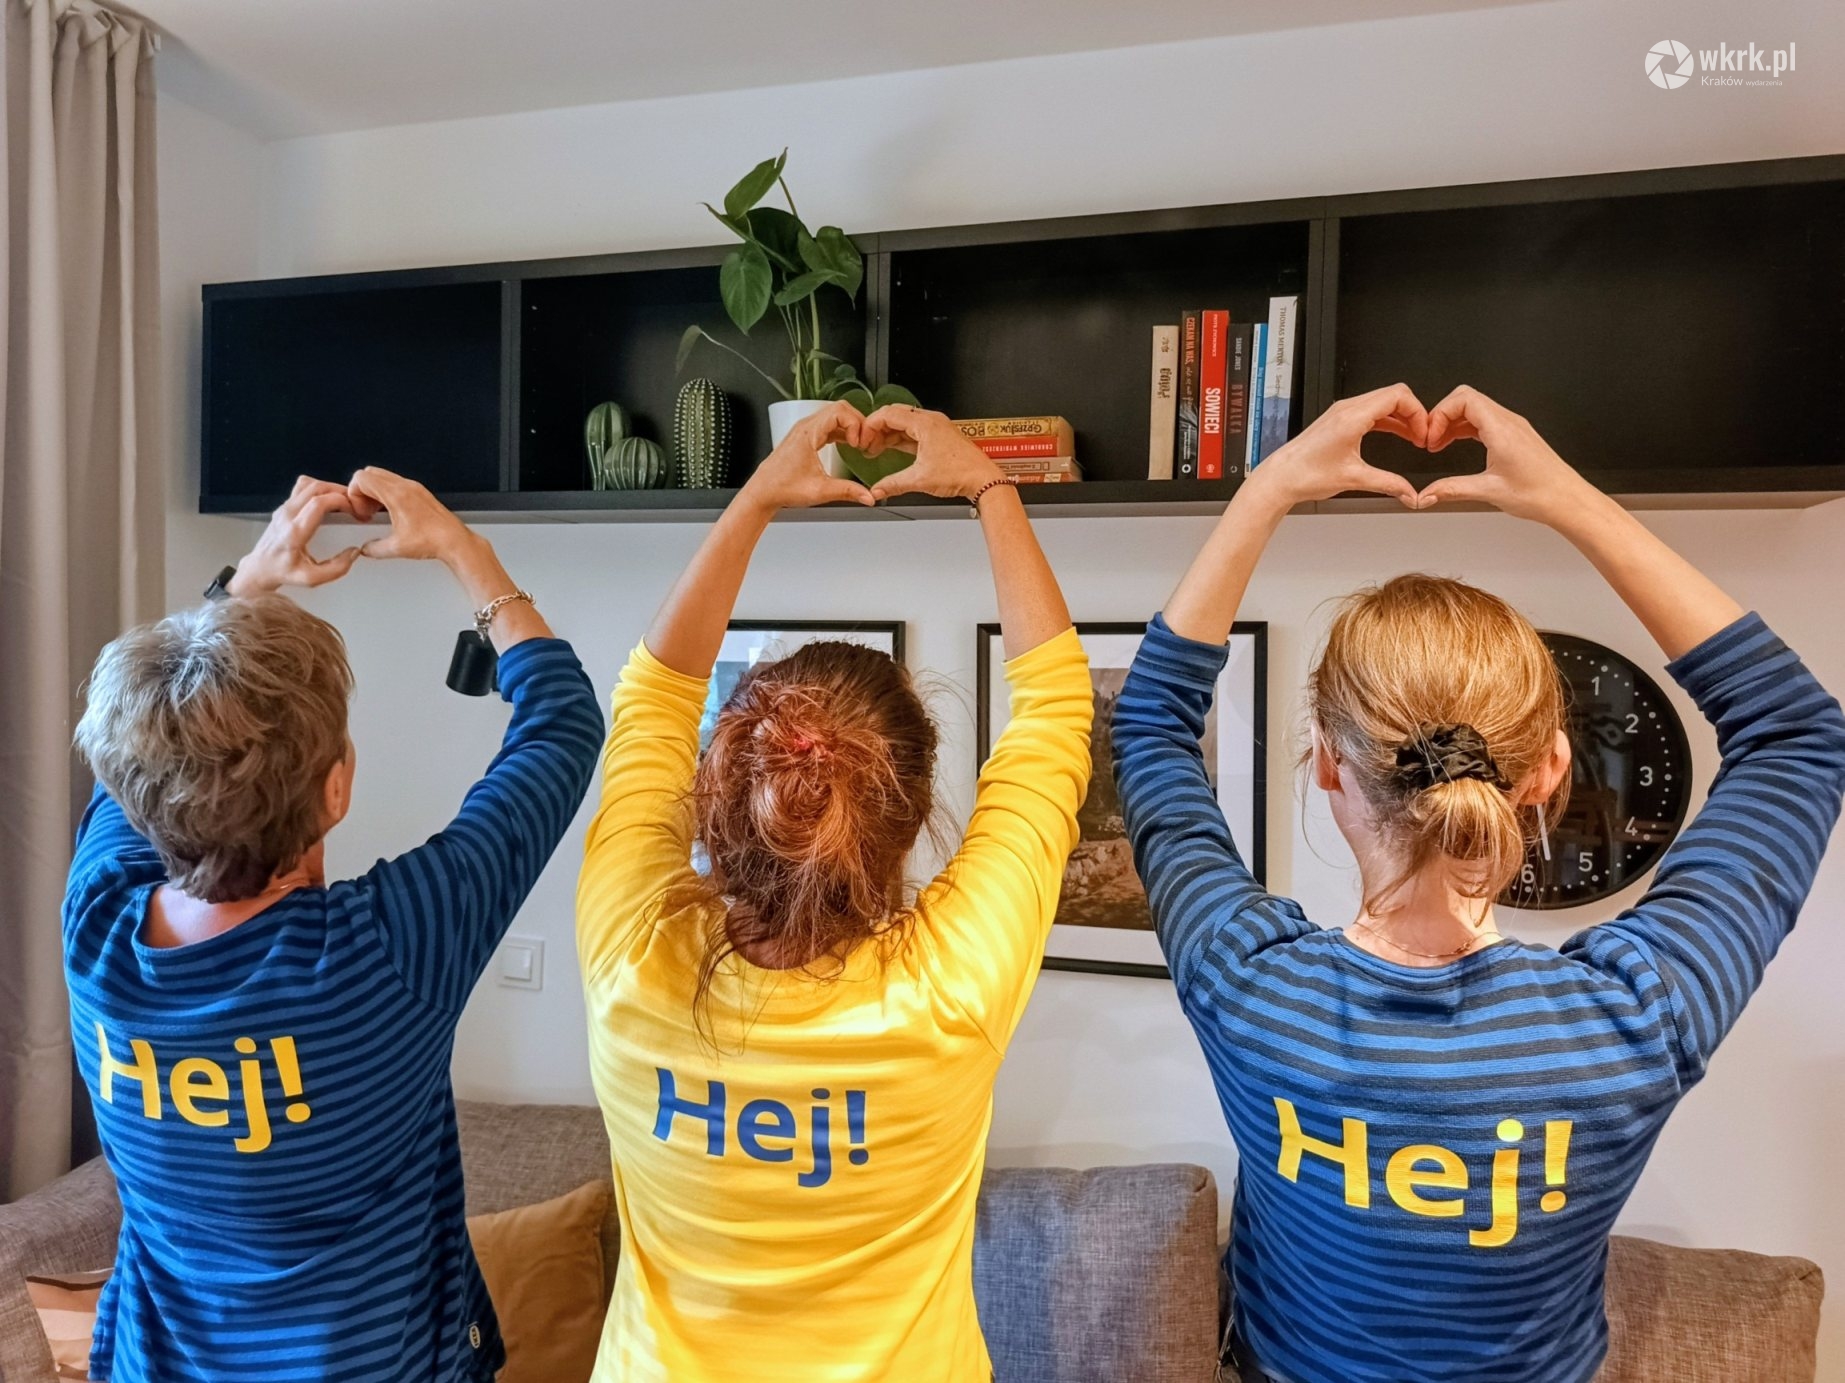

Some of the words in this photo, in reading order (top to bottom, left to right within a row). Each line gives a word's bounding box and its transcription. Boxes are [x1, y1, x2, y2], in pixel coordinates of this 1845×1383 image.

[1186, 317, 1196, 340] CZEKAM
[1279, 307, 1287, 336] THOMAS
[1185, 341, 1195, 349] NA
[1276, 338, 1285, 366] MERTON
[1234, 355, 1242, 371] JONES
[1204, 387, 1221, 434] SOWIECI
[961, 426, 985, 436] BOS
[1591, 676, 1600, 696] 1
[1625, 713, 1639, 733] 2
[1639, 766, 1653, 786] 3
[1624, 816, 1638, 836] 4
[1578, 852, 1593, 872] 5
[1521, 864, 1535, 884] 6
[94, 1021, 312, 1153] Hej!
[652, 1067, 869, 1187] Hej!
[1273, 1097, 1573, 1247] Hej!
